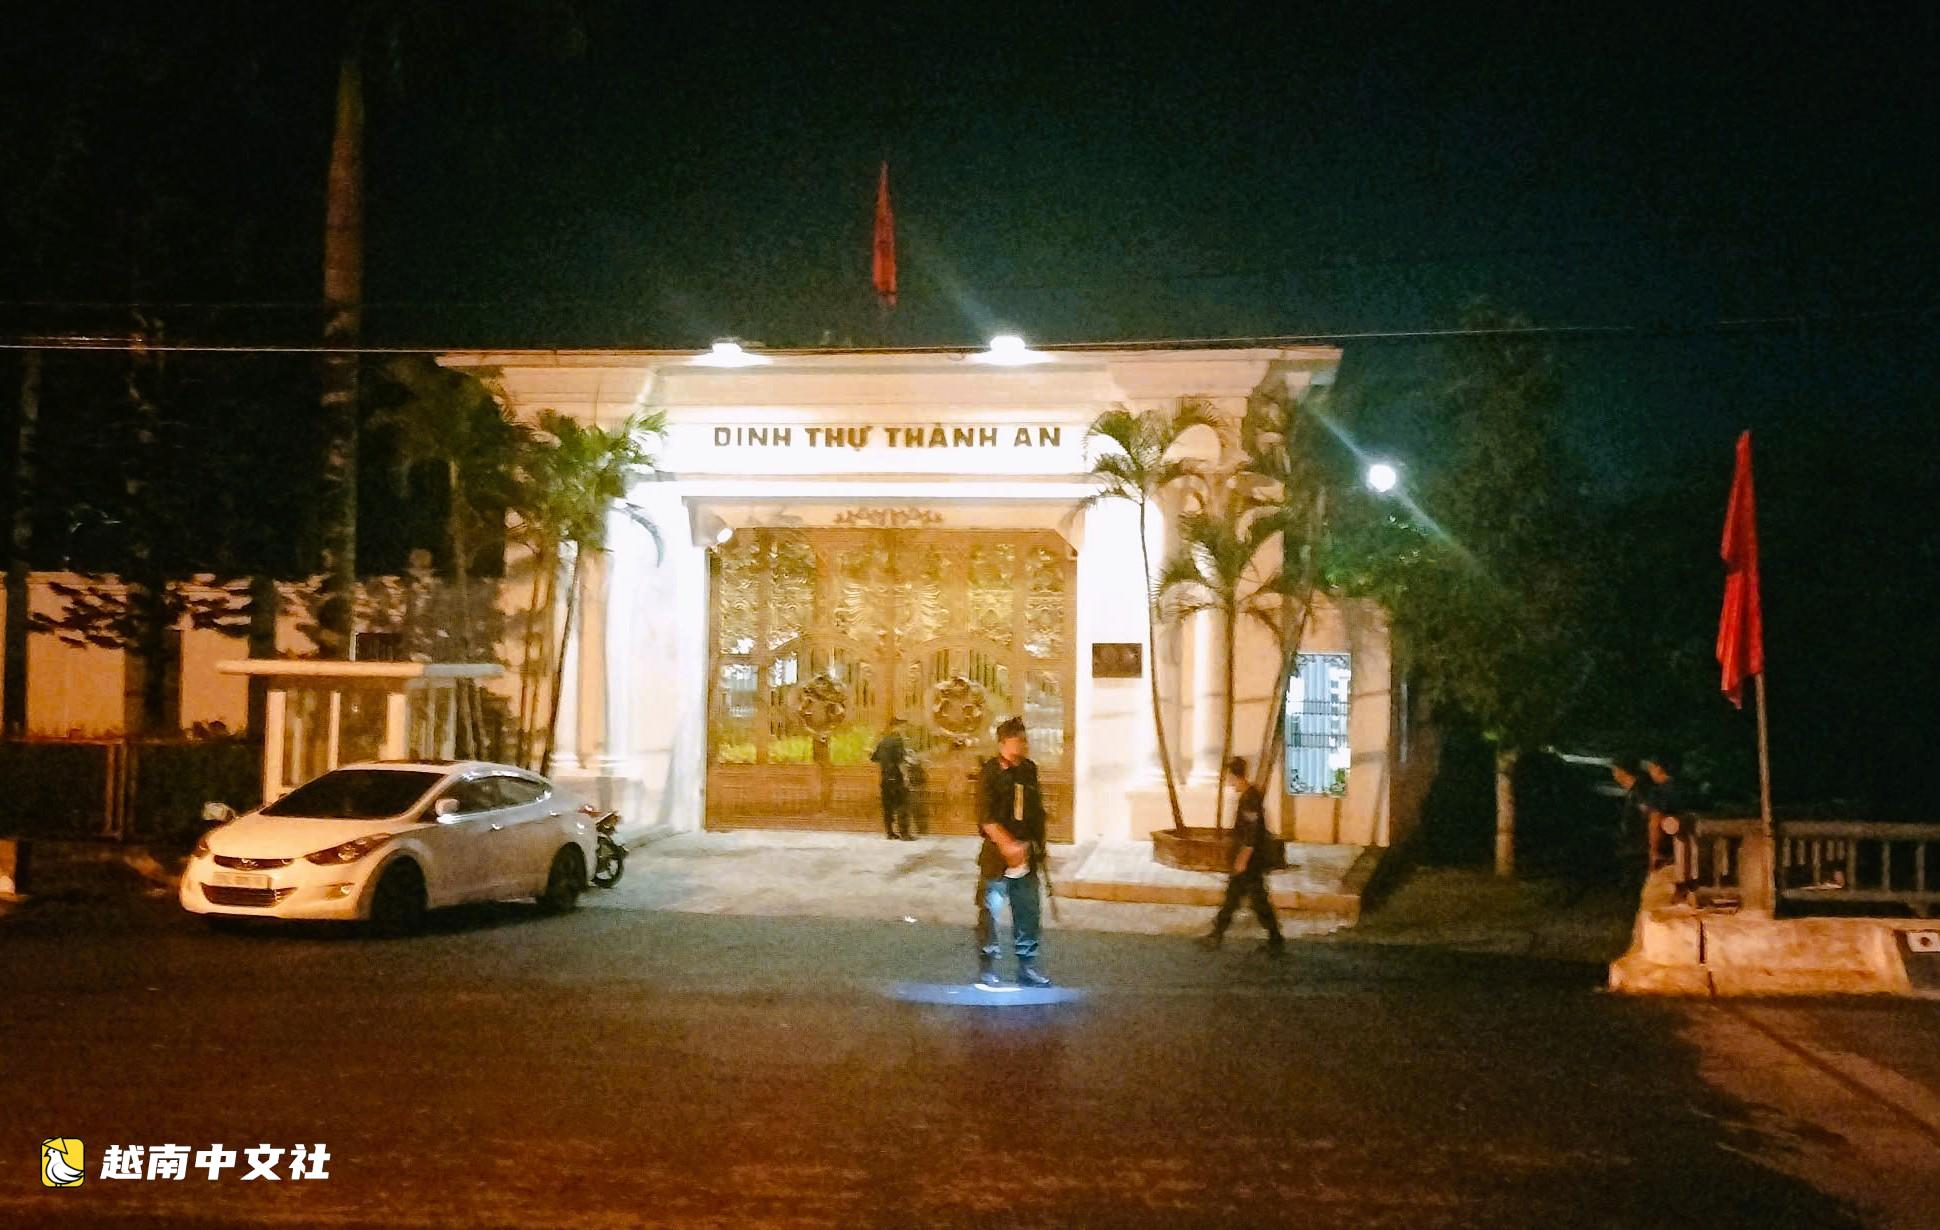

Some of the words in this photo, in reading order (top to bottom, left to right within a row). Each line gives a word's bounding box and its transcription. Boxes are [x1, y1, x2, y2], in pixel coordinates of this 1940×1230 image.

[714, 427, 792, 447] DINH
[804, 425, 873, 452] THỰ
[1013, 427, 1061, 447] AN
